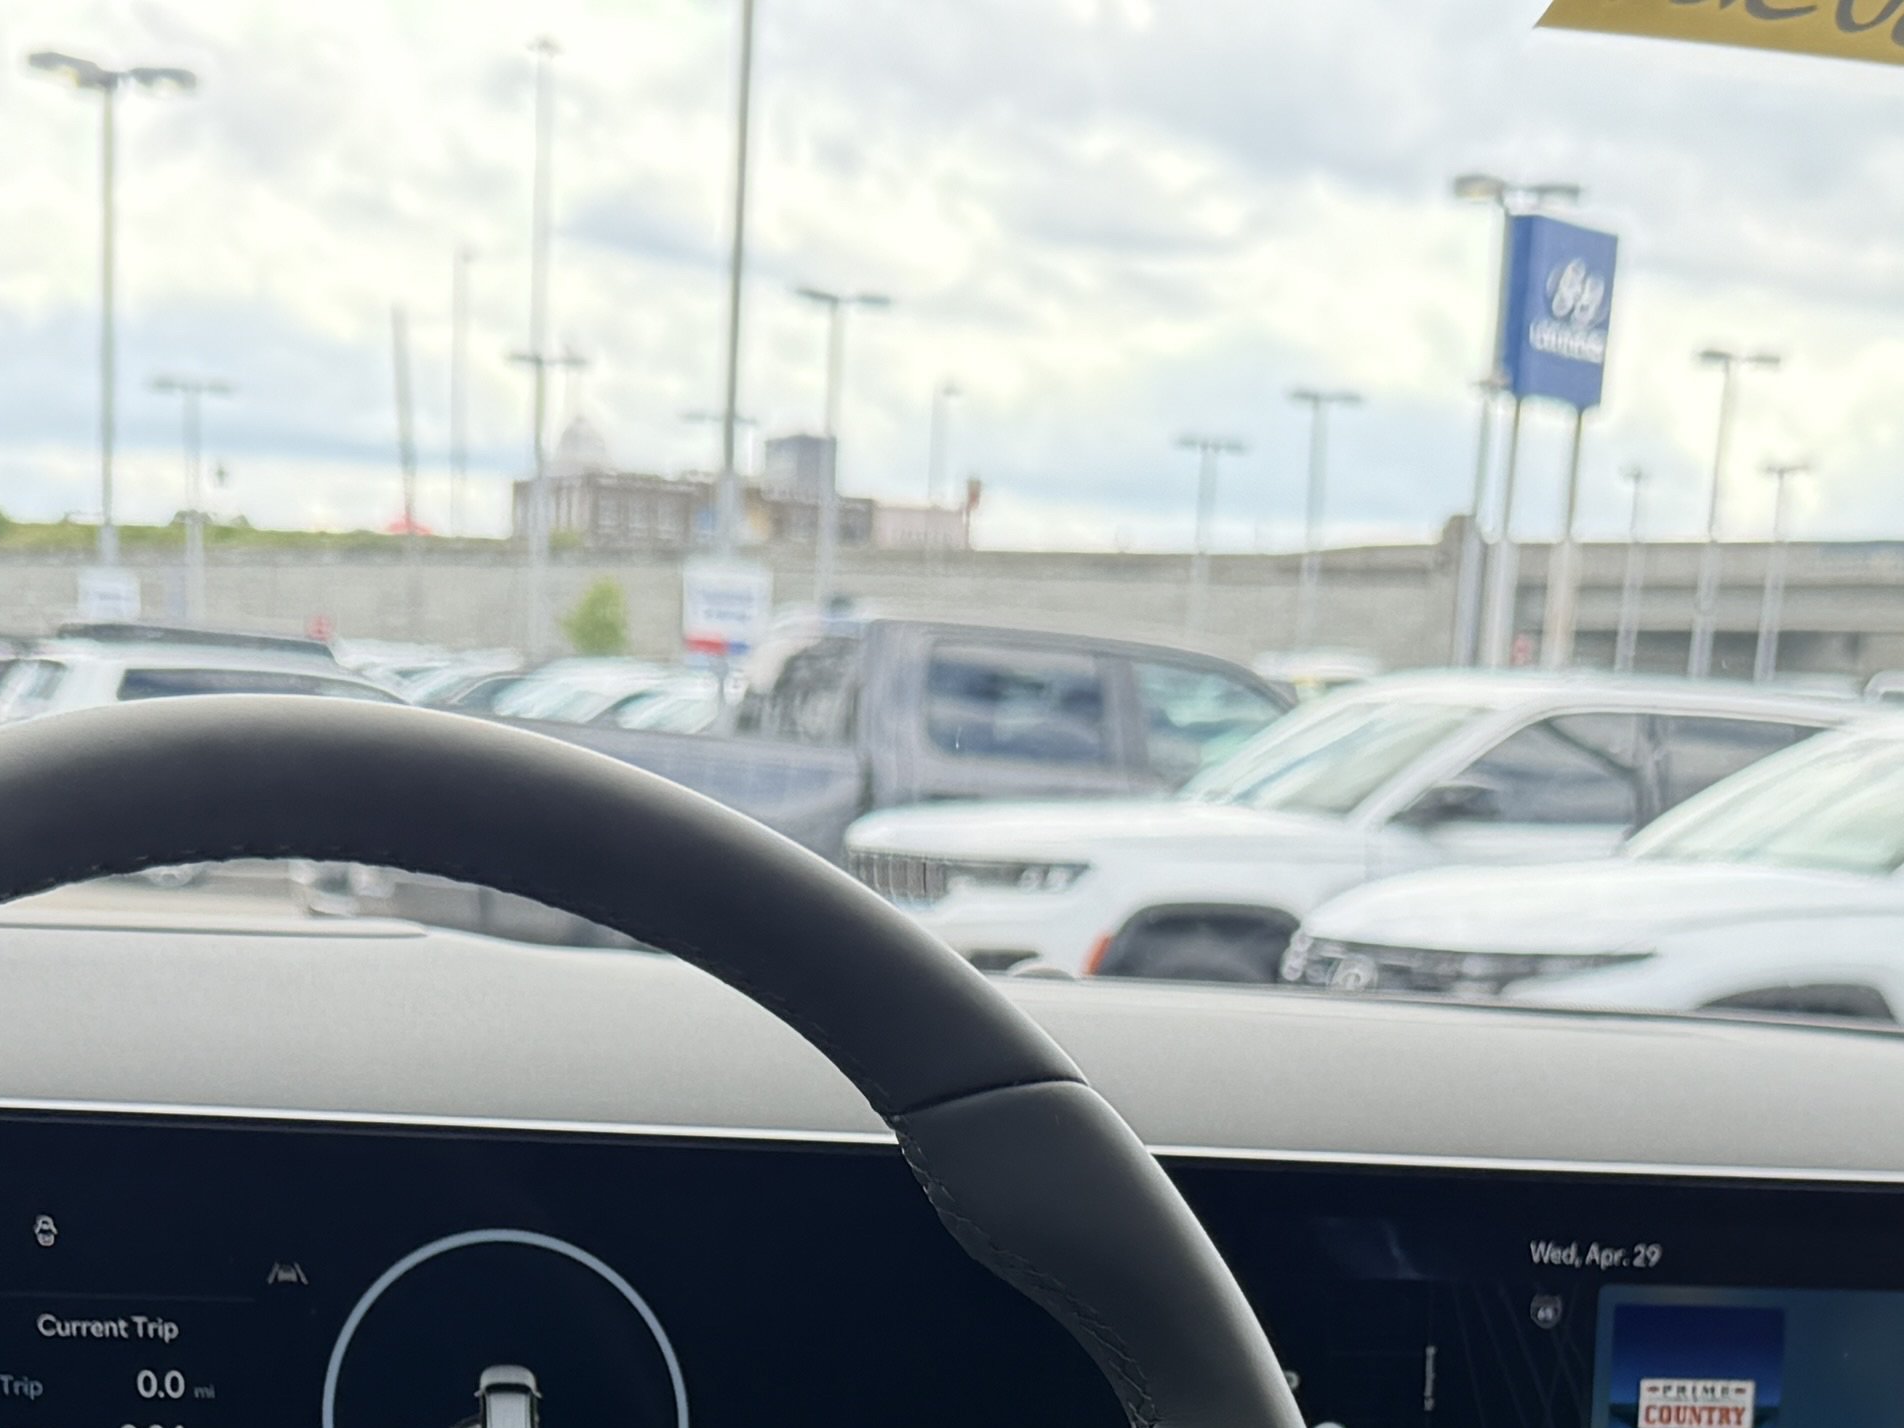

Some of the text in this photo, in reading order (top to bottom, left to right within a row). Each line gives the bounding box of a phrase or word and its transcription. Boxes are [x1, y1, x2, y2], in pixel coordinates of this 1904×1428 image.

[1585, 1244, 1629, 1271] Apr.
[1632, 1245, 1663, 1269] 29
[37, 1314, 179, 1342] Current Trip
[136, 1369, 186, 1399] 0.0
[1644, 1403, 1747, 1427] COUNTRY
